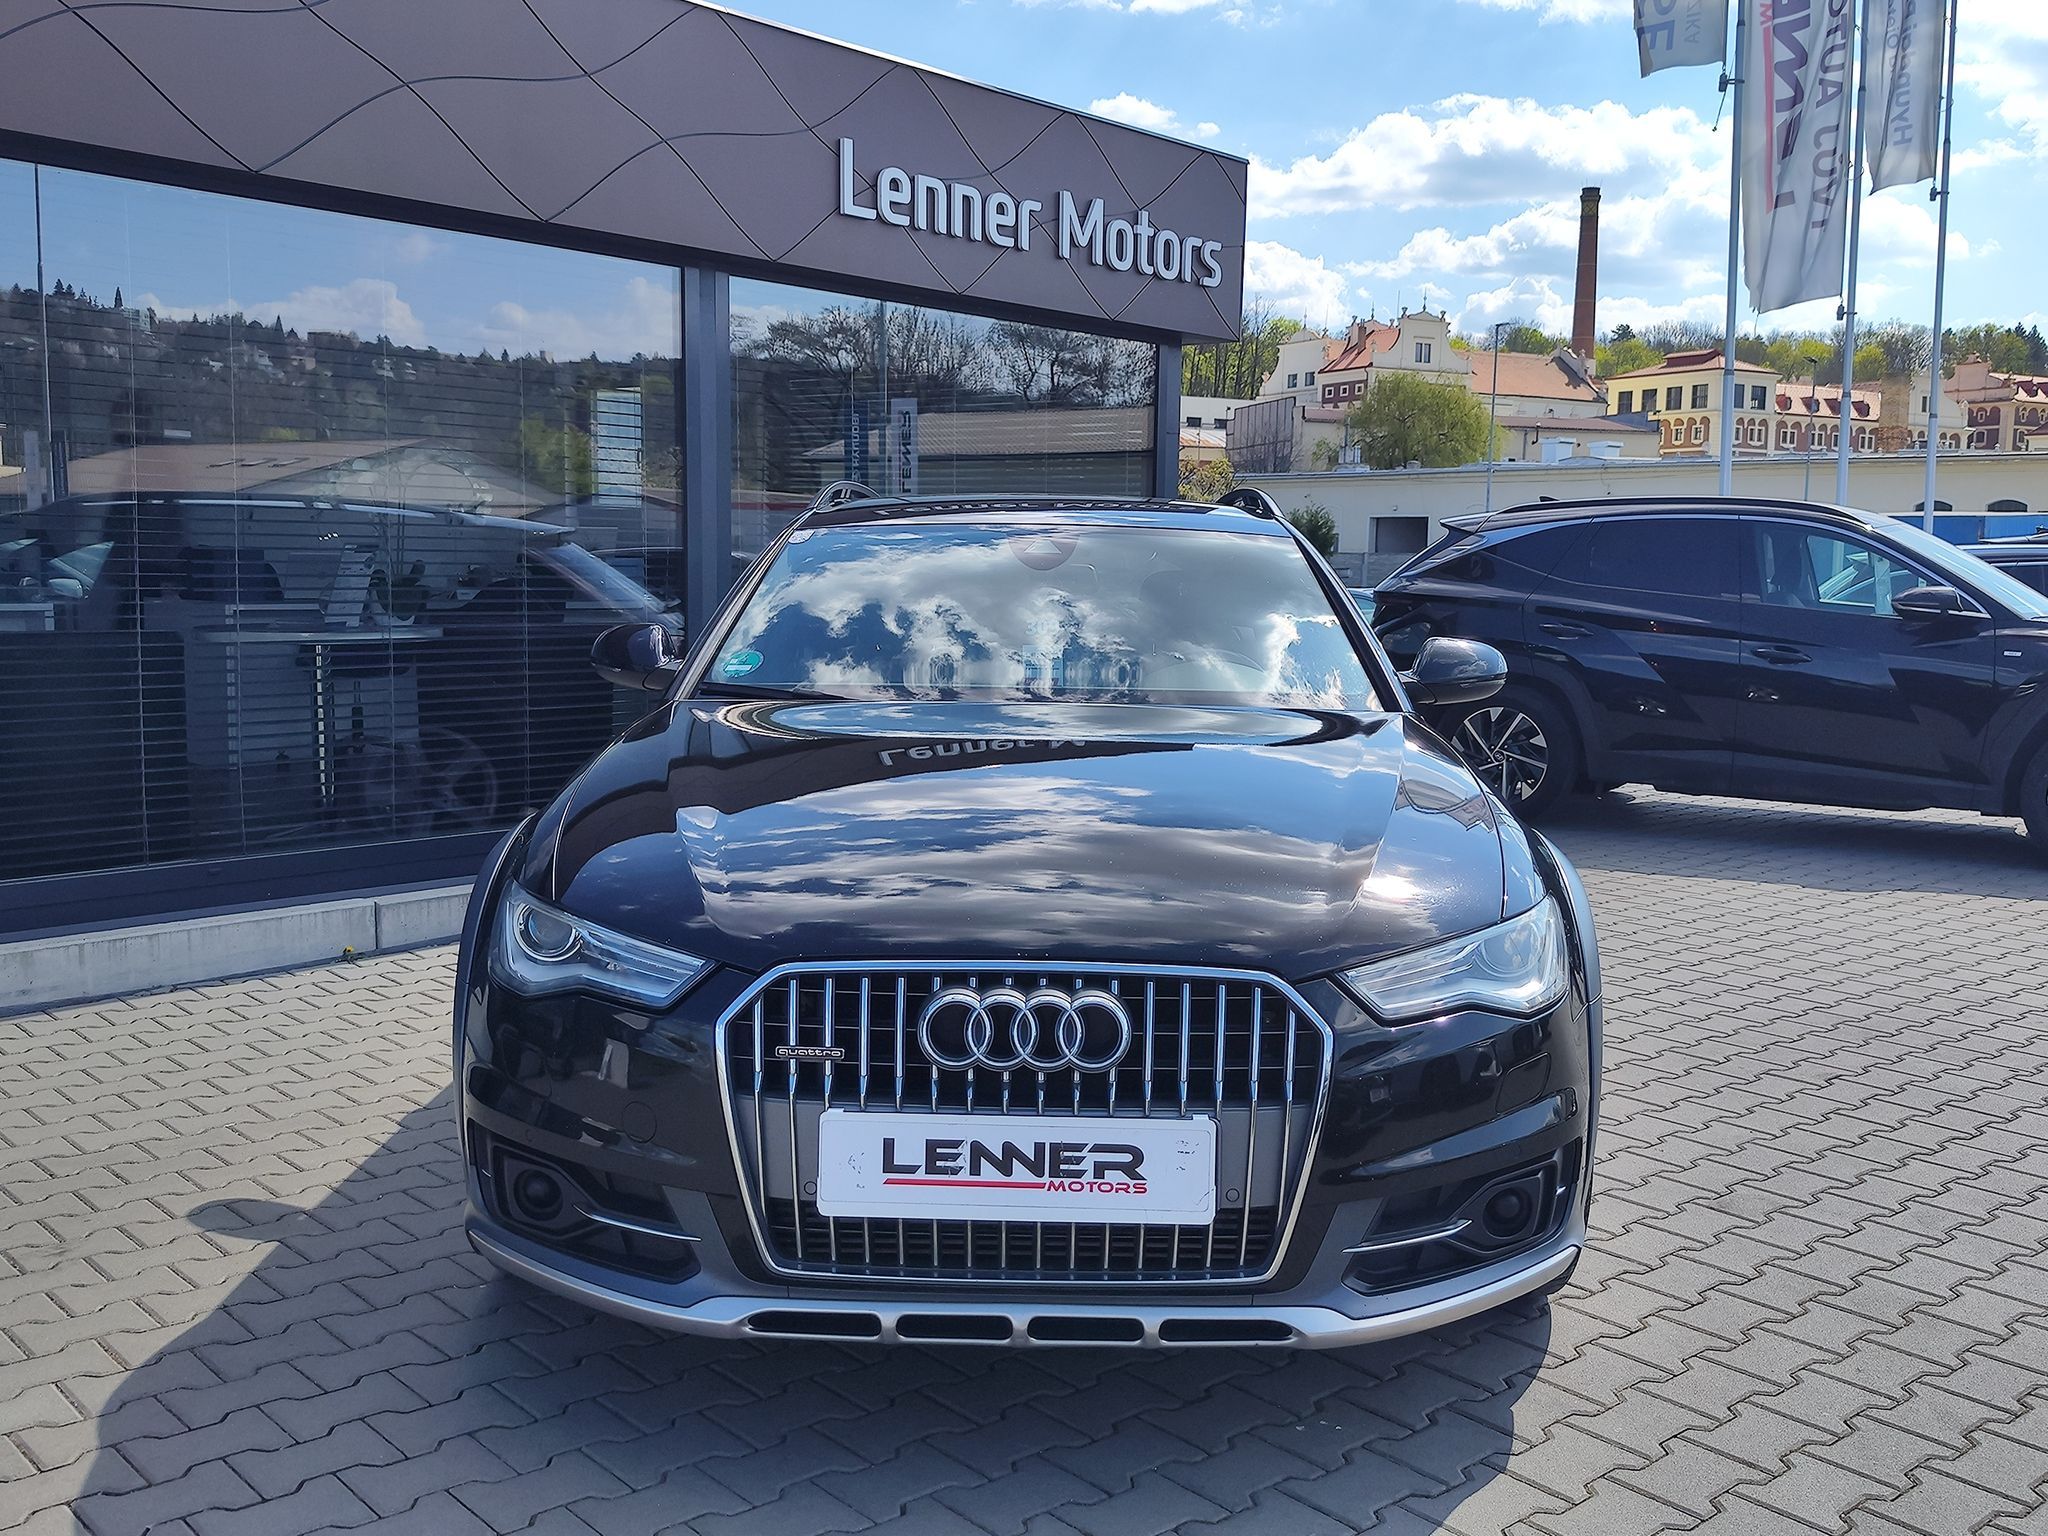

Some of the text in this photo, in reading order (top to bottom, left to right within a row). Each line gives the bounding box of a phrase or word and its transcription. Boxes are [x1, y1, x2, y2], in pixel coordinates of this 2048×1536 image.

[838, 136, 1223, 288] Lenner Motors
[778, 1048, 841, 1057] quattro
[882, 1137, 1148, 1181] LENNER
[1046, 1180, 1148, 1195] MOTORS
